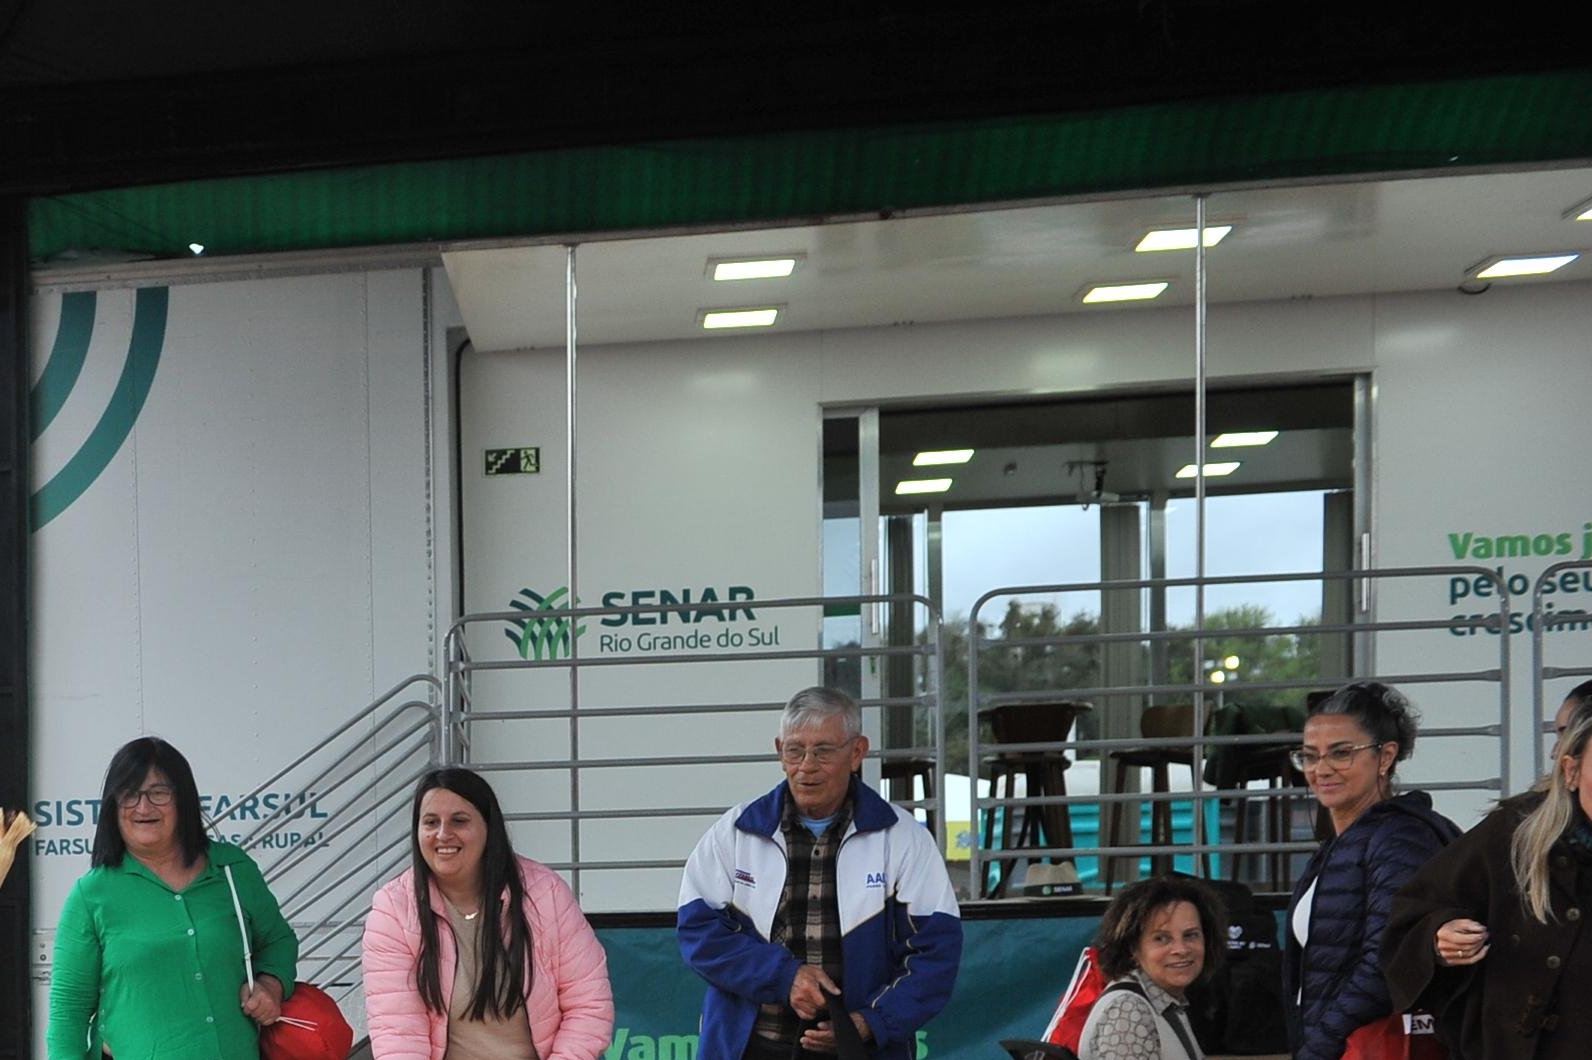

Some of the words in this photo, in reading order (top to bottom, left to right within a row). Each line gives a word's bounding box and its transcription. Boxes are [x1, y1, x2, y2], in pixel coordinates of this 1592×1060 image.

[1447, 531, 1572, 560] Vamos
[1580, 521, 1592, 561] j
[600, 586, 757, 628] SENAR
[600, 634, 632, 653] Rio
[637, 629, 711, 652] Grande
[716, 628, 743, 648] do
[748, 626, 780, 647] Sul
[33, 800, 99, 827] SIST
[198, 792, 328, 821] FARSUL
[35, 837, 93, 856] FARSU
